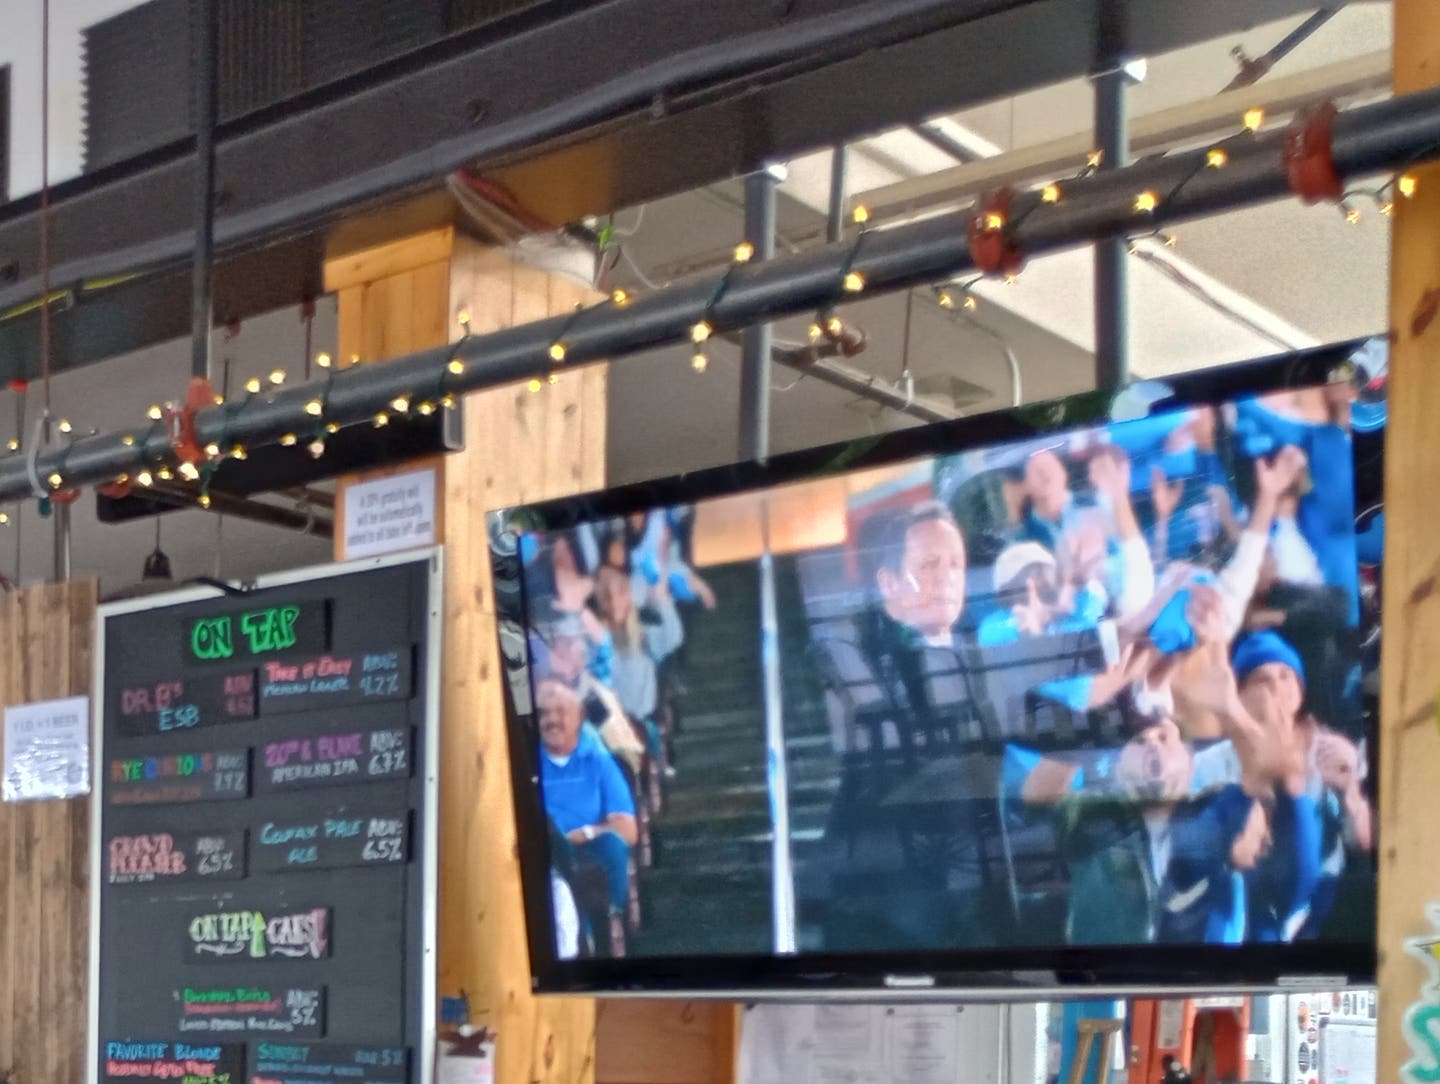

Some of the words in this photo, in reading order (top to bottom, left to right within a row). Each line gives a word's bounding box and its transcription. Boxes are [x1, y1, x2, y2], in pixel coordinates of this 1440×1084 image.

[192, 618, 232, 658] ON
[242, 607, 299, 653] TAP
[189, 917, 218, 943] ON
